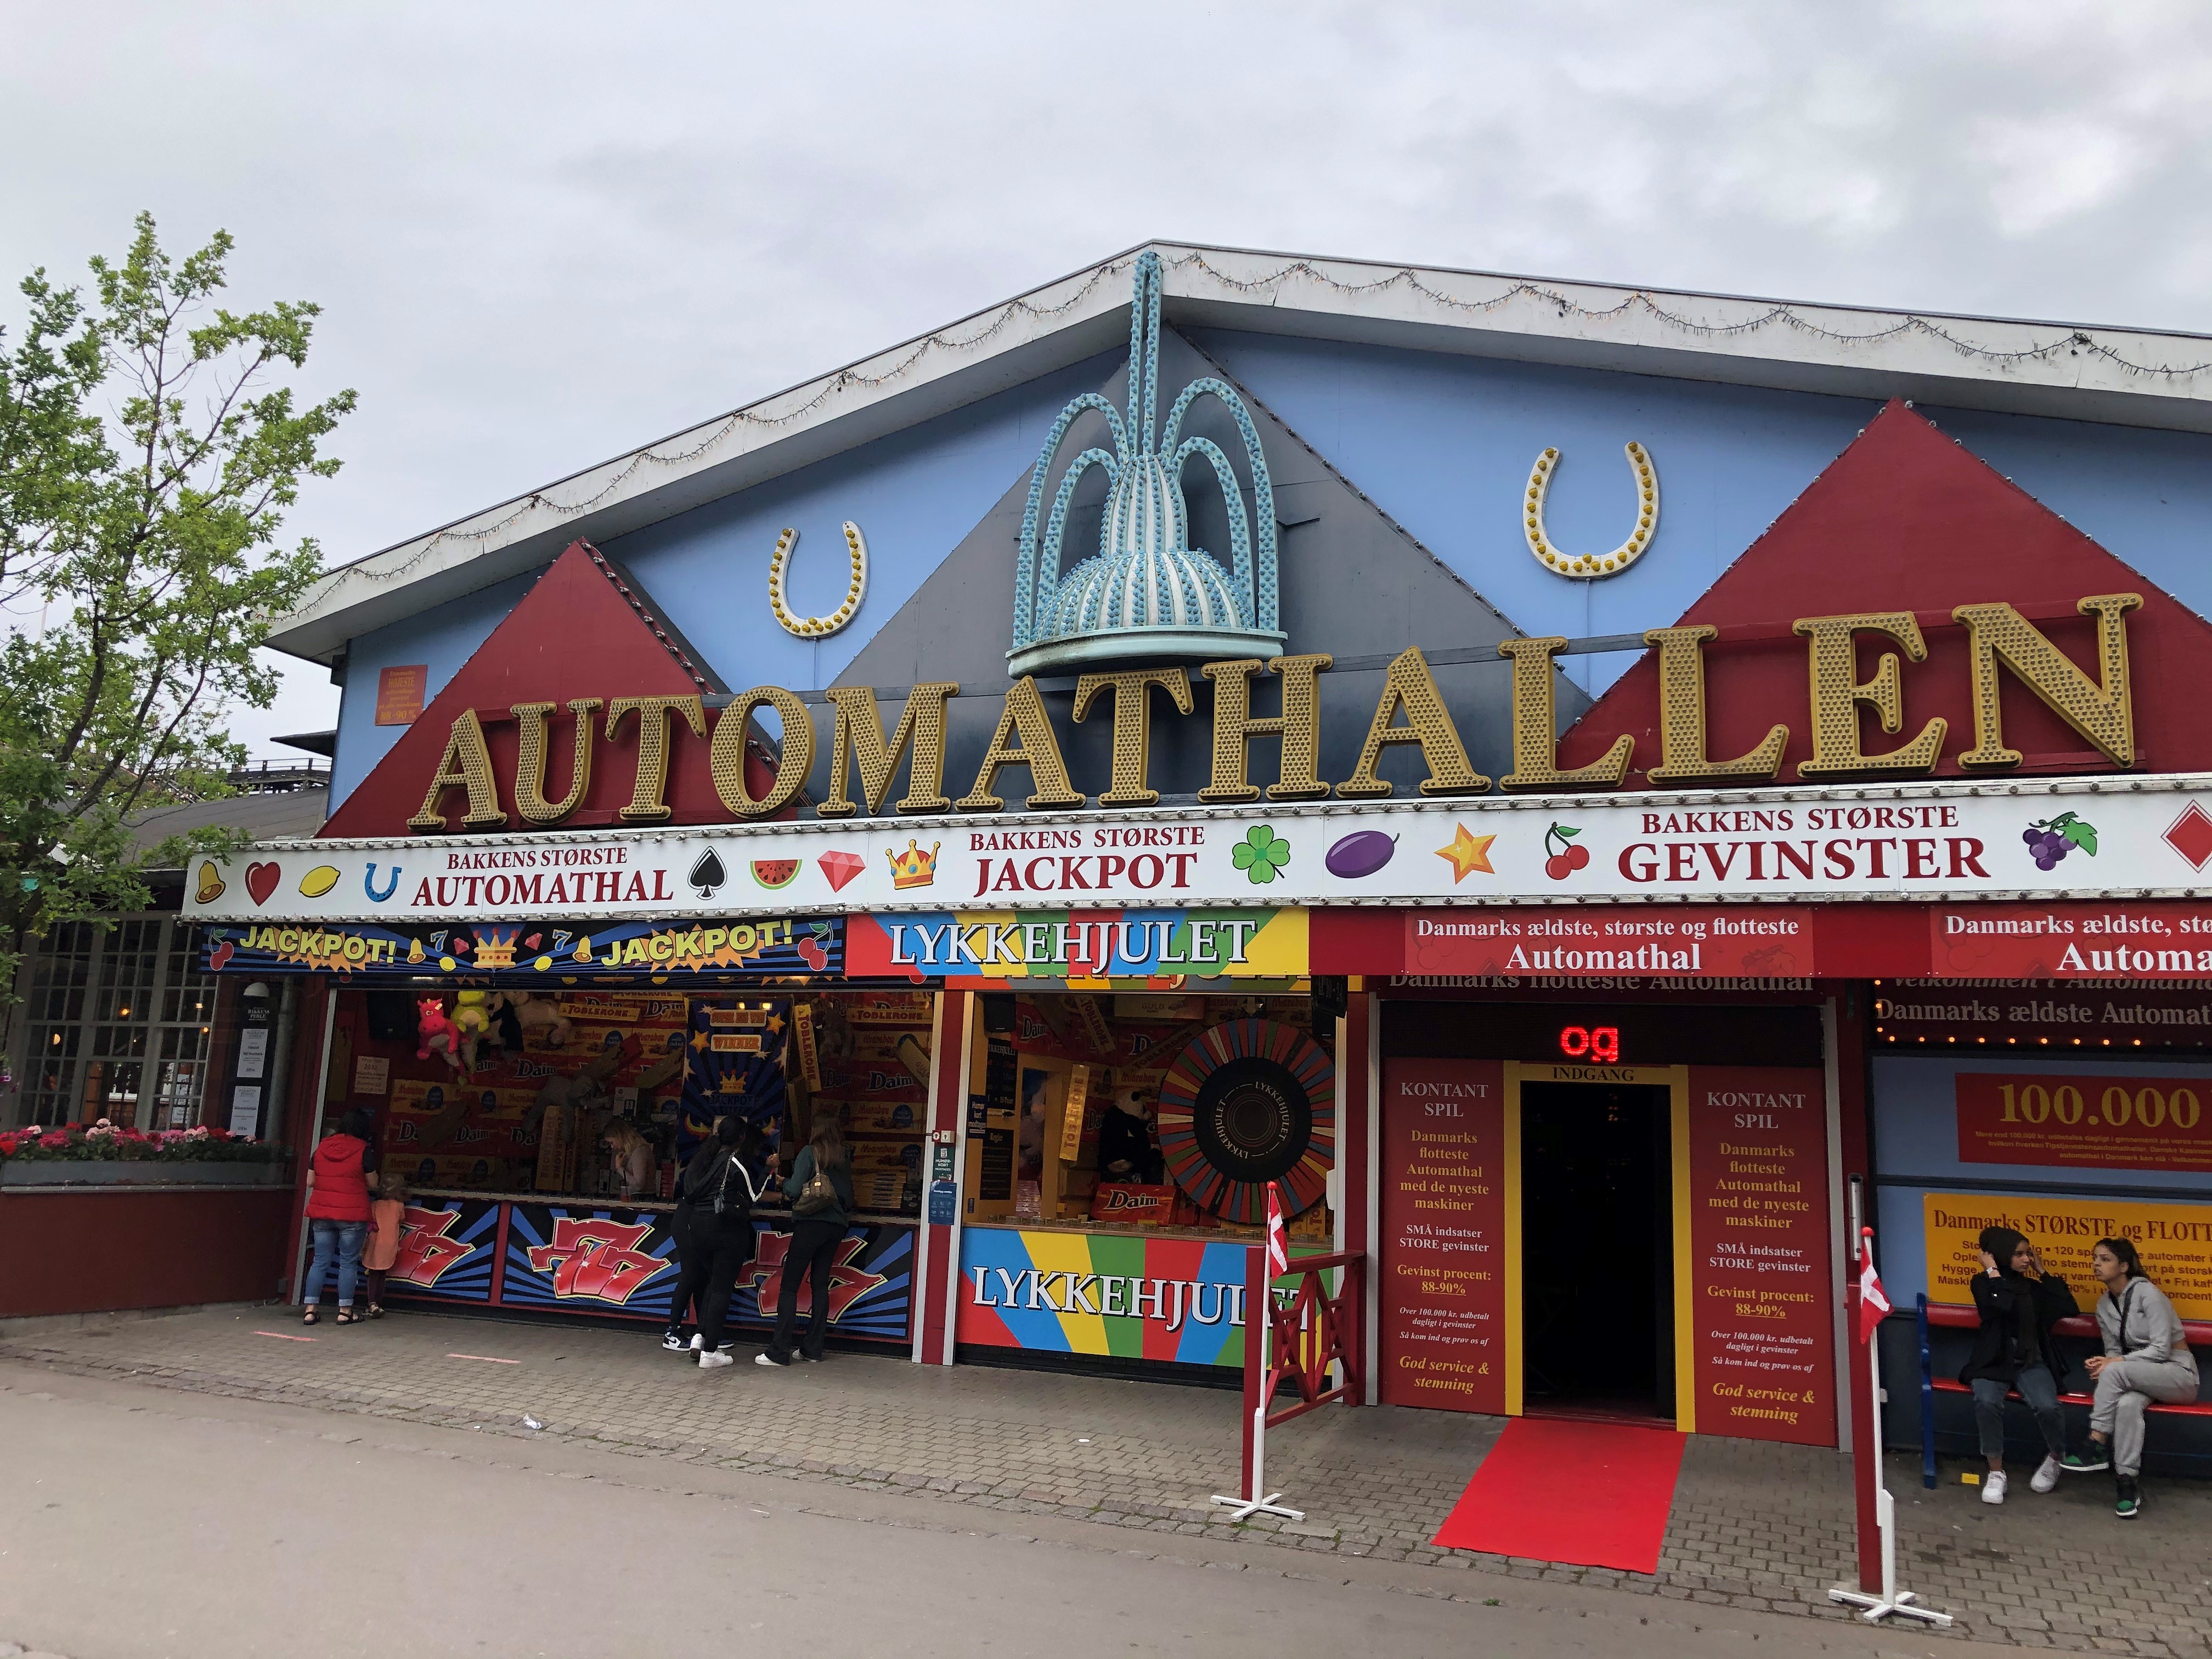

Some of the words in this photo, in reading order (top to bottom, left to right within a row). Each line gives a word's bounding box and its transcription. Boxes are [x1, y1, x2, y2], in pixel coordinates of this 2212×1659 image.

[406, 592, 2143, 831] AUTOMATHALLEN
[1642, 810, 1793, 834] BAKKENS
[1807, 805, 1958, 830] STØRSTE
[969, 831, 1082, 851] BAKKENS
[1094, 826, 1204, 848] STØRSTE
[447, 851, 535, 870] BAKKENS
[541, 847, 627, 867] STØRSTE
[1618, 837, 1991, 882] GEVINSTER
[973, 853, 1198, 898] JACKPOT
[411, 870, 674, 907] AUTOMATHAL
[1417, 918, 1521, 938] Danmarks
[1527, 918, 1598, 939] ældste,
[1604, 918, 1675, 937] største
[1680, 922, 1707, 941] og
[1712, 917, 1799, 936] flotteste
[1946, 915, 2074, 934] Danmarks
[2083, 915, 2172, 937] ældste,
[240, 926, 397, 963] JACKPOT!
[601, 919, 792, 968] JACKPOT!
[890, 919, 1256, 975] LYKKEHJULET
[1505, 943, 1702, 970] Automathal
[2056, 943, 2212, 972] Automa
[568, 1005, 629, 1017] TOBLERONE
[857, 1010, 923, 1020] TOBLERONE
[1877, 998, 2000, 1023] Danmarks
[2008, 1000, 2092, 1024] ældste
[713, 1036, 760, 1049] WINNER
[1561, 1026, 1620, 1063] og
[514, 1058, 557, 1078] Daim
[1553, 1066, 1635, 1082] INDGANG
[866, 1070, 915, 1092] Daim
[1401, 1082, 1488, 1098] KONTANT
[1707, 1092, 1806, 1108] KONTANT
[1998, 1082, 2201, 1129] 100.000
[1425, 1103, 1464, 1117] SPIL
[1735, 1114, 1779, 1128] SPIL
[1411, 1130, 1477, 1143] Danmarks
[1419, 1147, 1469, 1160] flotteste
[1720, 1142, 1795, 1157] Danmarks
[1406, 1164, 1482, 1177] Automathal
[1729, 1160, 1785, 1174] flotteste
[1400, 1181, 1426, 1192] med
[1430, 1181, 1446, 1193] de
[1449, 1184, 1489, 1197] nyeste
[1716, 1178, 1801, 1193] Automathal
[1103, 1189, 1161, 1211] Daim
[1414, 1199, 1474, 1211] maskiner
[1709, 1197, 1738, 1208] med
[1743, 1197, 1760, 1209] de
[1764, 1200, 1809, 1213] nyeste
[1725, 1215, 1792, 1228] maskiner
[1934, 1209, 2021, 1232] Danmarks
[2025, 1214, 2116, 1237] STØRSTE
[2122, 1223, 2143, 1243] og
[2147, 1220, 2212, 1242] FLOTT
[1406, 1223, 1432, 1235] SMÅ
[1435, 1226, 1482, 1238] indsatser
[1400, 1238, 1439, 1249] STORE
[1442, 1240, 1489, 1252] gevinster
[1717, 1242, 1746, 1254] SMÅ
[1750, 1245, 1803, 1257] indsatser
[2055, 1246, 2073, 1256] 120
[2147, 1252, 2206, 1262] automater
[1397, 1264, 1440, 1277] Gevinst
[1443, 1268, 1492, 1281] procent:
[1709, 1257, 1754, 1269] STORE
[1758, 1260, 1811, 1273] gevinster
[1942, 1263, 1977, 1276] Hygge
[2160, 1265, 2175, 1275] på
[1421, 1281, 1466, 1295] 88-90%
[2175, 1277, 2190, 1286] Fri
[1707, 1285, 1756, 1299] Gevinst
[1760, 1290, 1814, 1303] procent:
[1400, 1307, 1417, 1315] Over
[1419, 1308, 1447, 1317] 100.000
[1448, 1310, 1458, 1318] kr.
[1460, 1311, 1490, 1321] udbetalt
[1735, 1303, 1787, 1319] 88-90%
[1412, 1317, 1437, 1327] dagligt
[1443, 1319, 1476, 1329] gevinster
[1400, 1331, 1409, 1339] Så
[1427, 1334, 1440, 1342] ind
[1442, 1336, 1451, 1344] og
[1480, 1338, 1490, 1346] af
[1711, 1330, 1731, 1339] Over
[1733, 1331, 1765, 1341] 100.000
[1767, 1334, 1777, 1342] kr.
[1780, 1335, 1813, 1345] udbetalt
[1726, 1342, 1754, 1353] dagligt
[1756, 1344, 1759, 1352] i
[1760, 1344, 1798, 1355] gevinster
[1400, 1356, 1426, 1370] God
[1429, 1359, 1474, 1374] service
[1478, 1362, 1490, 1374] &
[1712, 1356, 1723, 1364] Så
[1725, 1357, 1742, 1366] kom
[1745, 1358, 1758, 1368] ind
[1760, 1361, 1770, 1370] og
[1804, 1363, 1815, 1373] af
[1414, 1376, 1475, 1394] stemning
[1713, 1382, 1743, 1397] God
[1746, 1386, 1798, 1402] service
[1802, 1390, 1815, 1403] &
[1730, 1404, 1799, 1425] stemning
